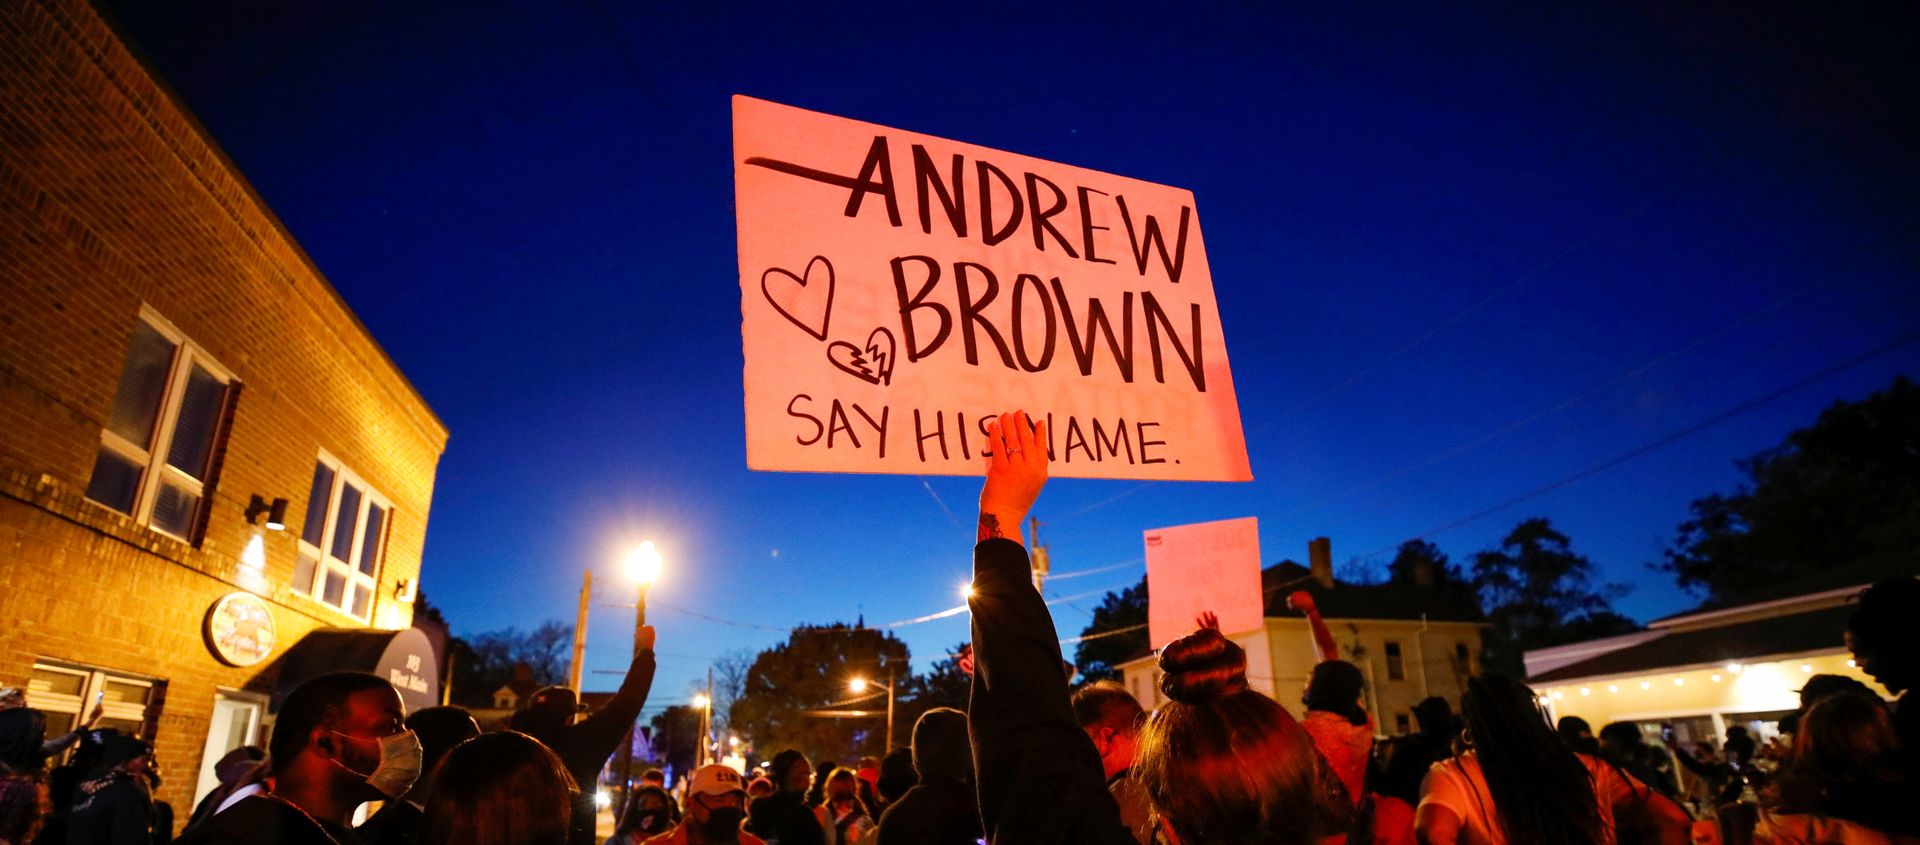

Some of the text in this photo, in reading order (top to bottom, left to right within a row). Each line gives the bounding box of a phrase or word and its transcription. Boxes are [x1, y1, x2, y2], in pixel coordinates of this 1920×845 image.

[745, 136, 1190, 284] ANDREW
[890, 255, 1207, 393] BROWN
[787, 394, 888, 459] SAY
